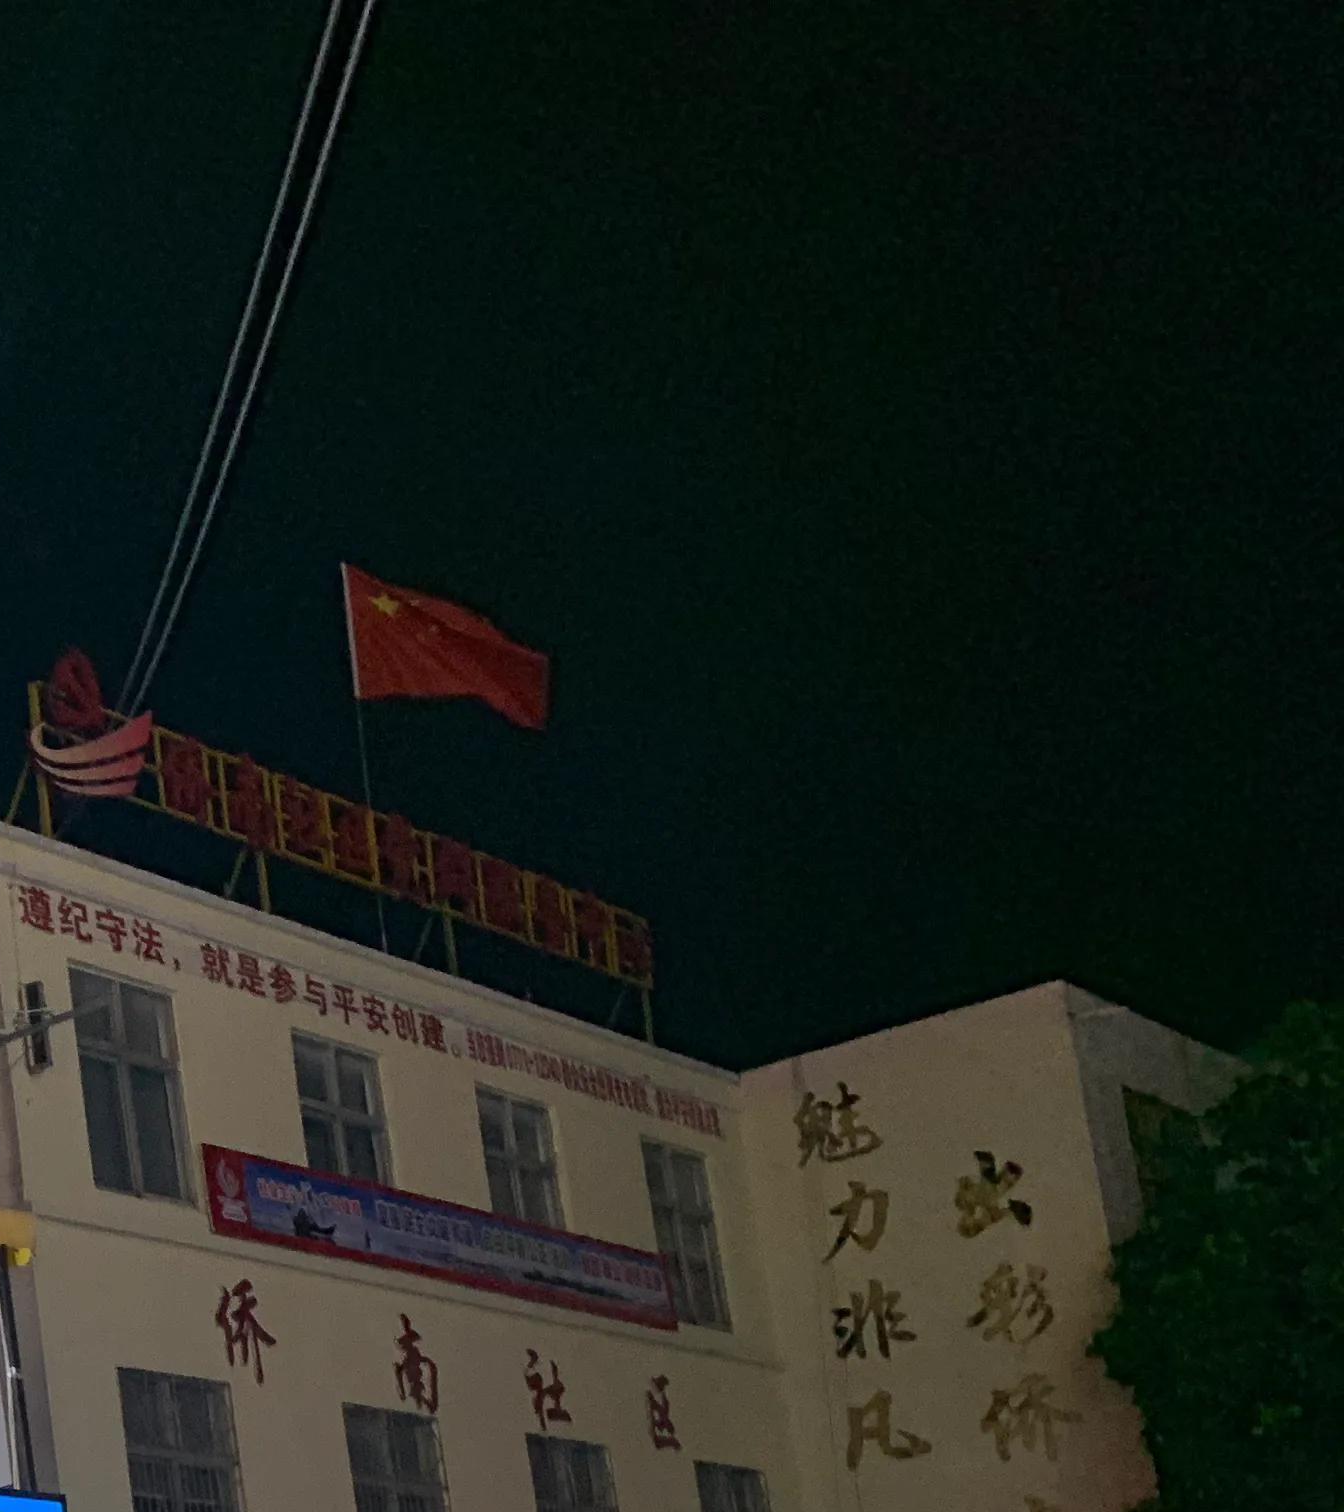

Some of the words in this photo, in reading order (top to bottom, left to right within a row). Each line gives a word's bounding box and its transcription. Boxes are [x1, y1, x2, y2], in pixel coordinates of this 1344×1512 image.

[215, 1277, 682, 1450] 侨南社区
[792, 1082, 932, 1472] 魅力非凡
